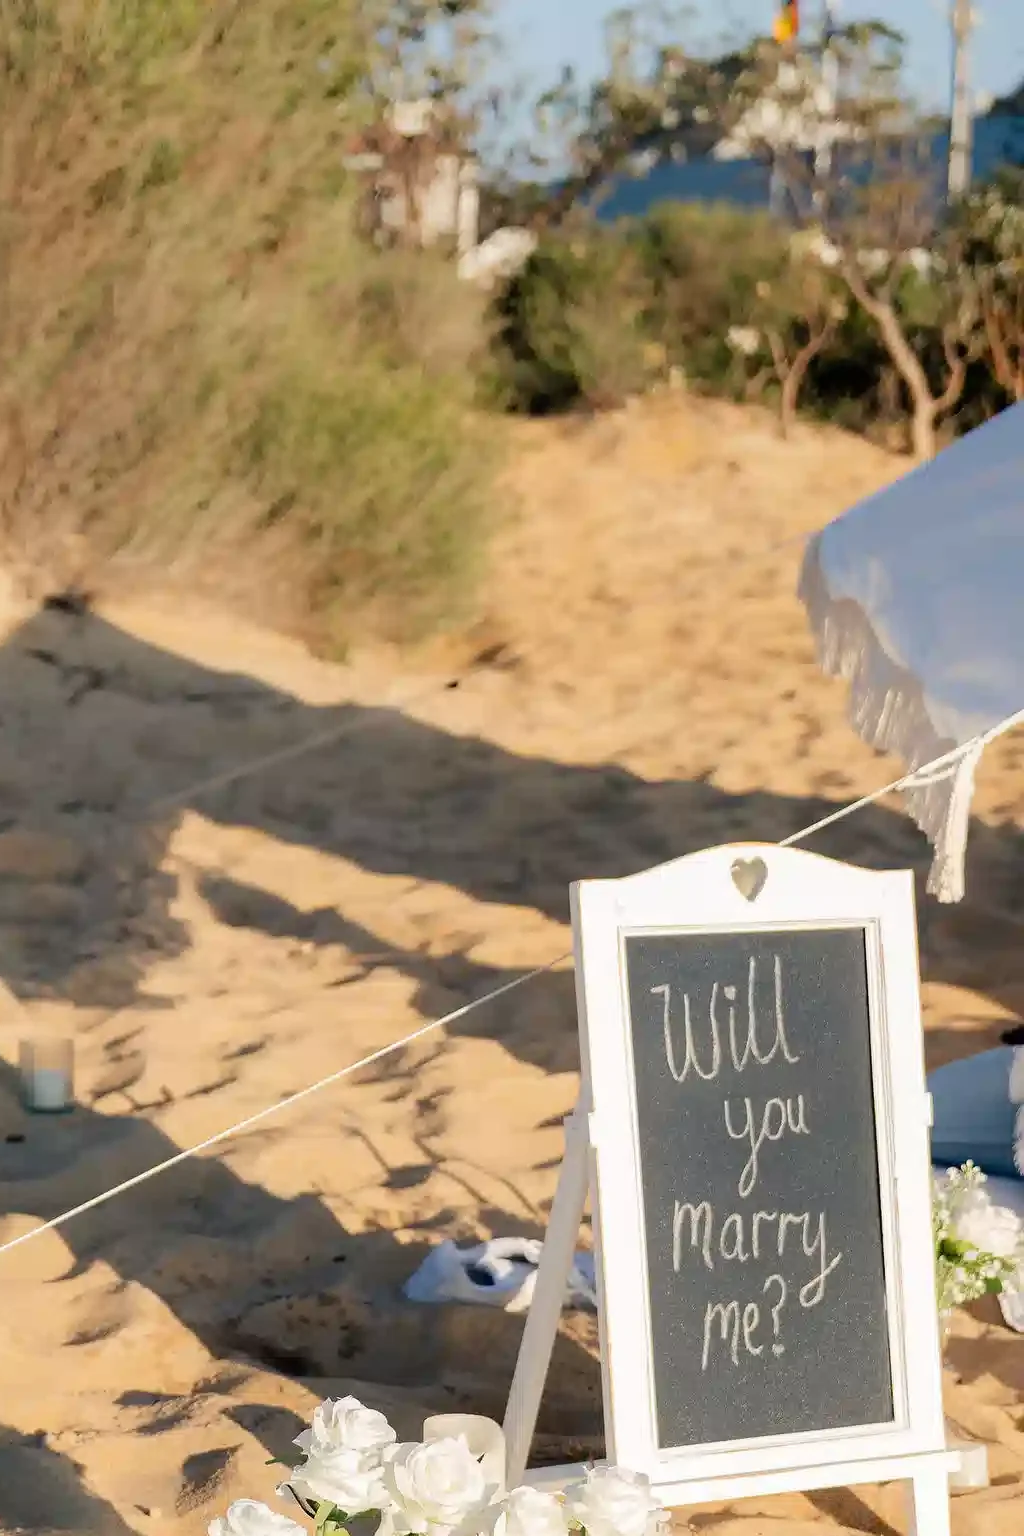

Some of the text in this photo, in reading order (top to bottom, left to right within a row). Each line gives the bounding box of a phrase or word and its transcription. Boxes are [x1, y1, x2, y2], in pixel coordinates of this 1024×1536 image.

[651, 955, 799, 1082] Will
[724, 1094, 810, 1198] you
[701, 1274, 787, 1371] me?
